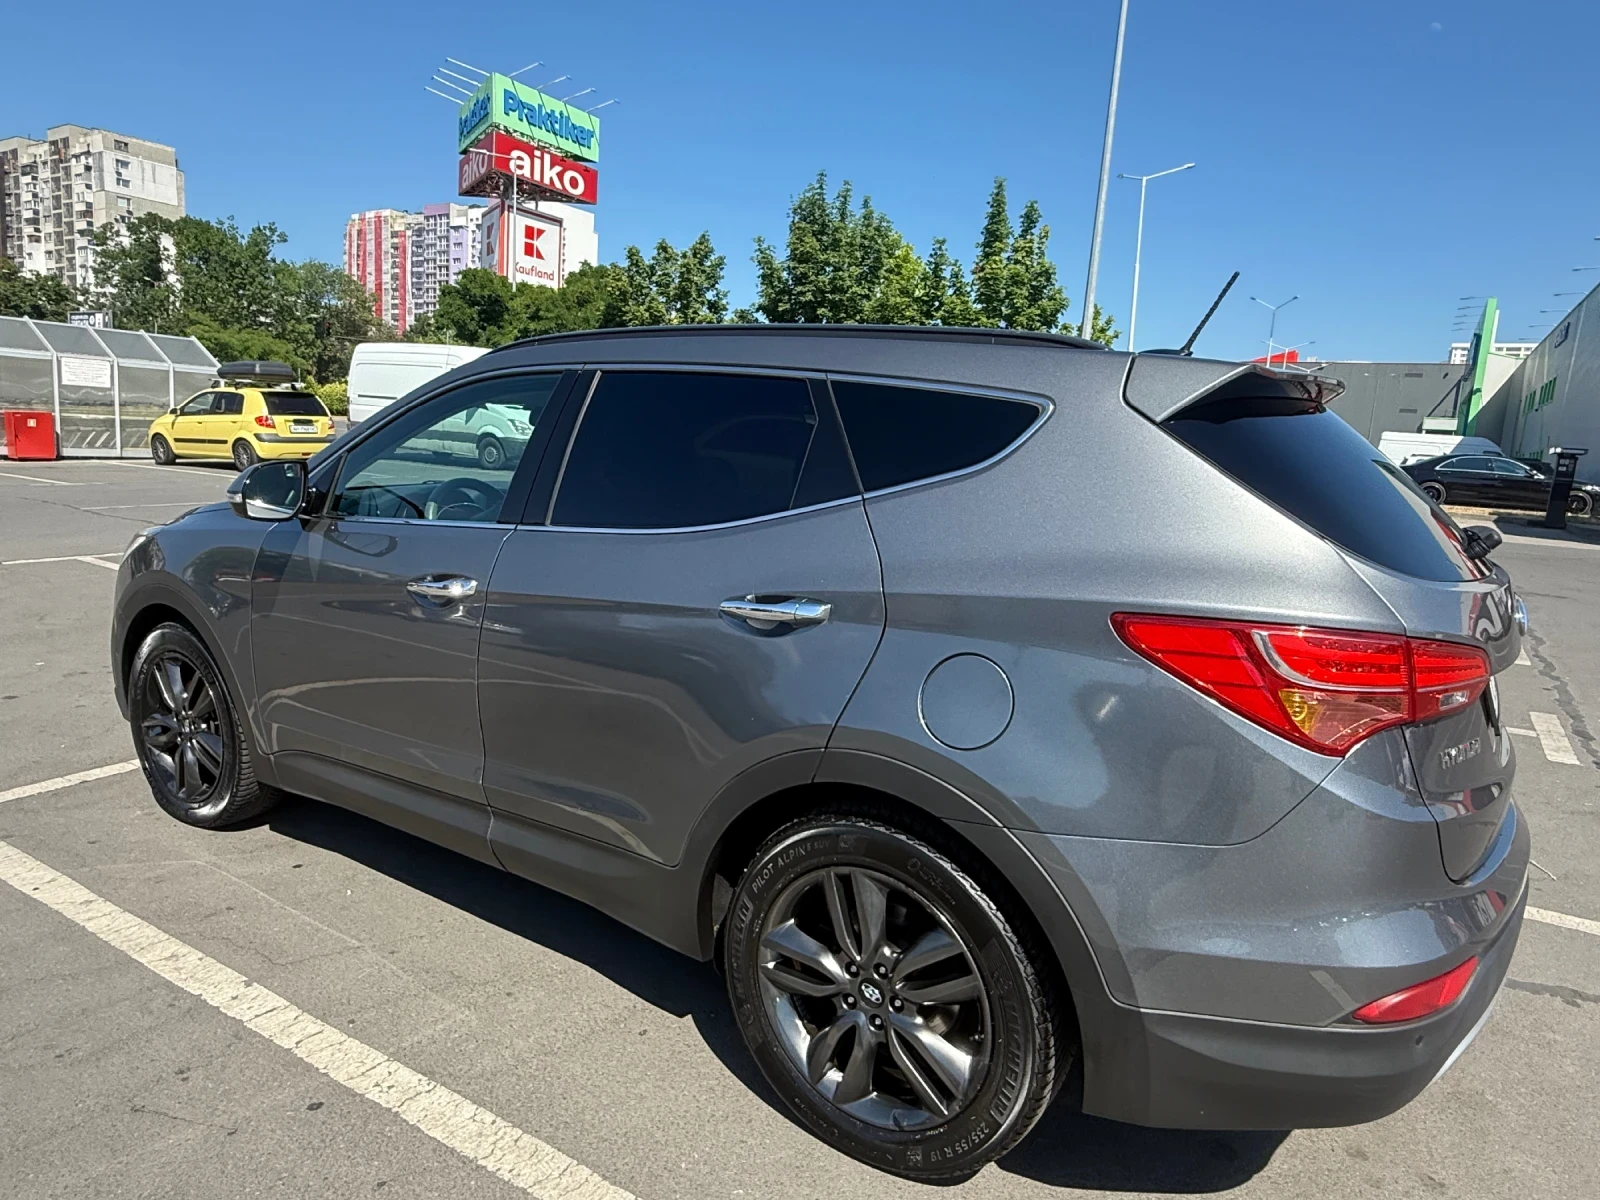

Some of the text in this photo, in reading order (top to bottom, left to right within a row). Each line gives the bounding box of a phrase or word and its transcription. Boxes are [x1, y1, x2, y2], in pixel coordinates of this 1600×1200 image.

[503, 88, 595, 149] Praktiker
[461, 151, 488, 188] aiko
[509, 149, 585, 196] aiko
[751, 863, 775, 894] PILOT
[944, 1146, 954, 1158] R
[955, 1121, 990, 1154] 235/55
